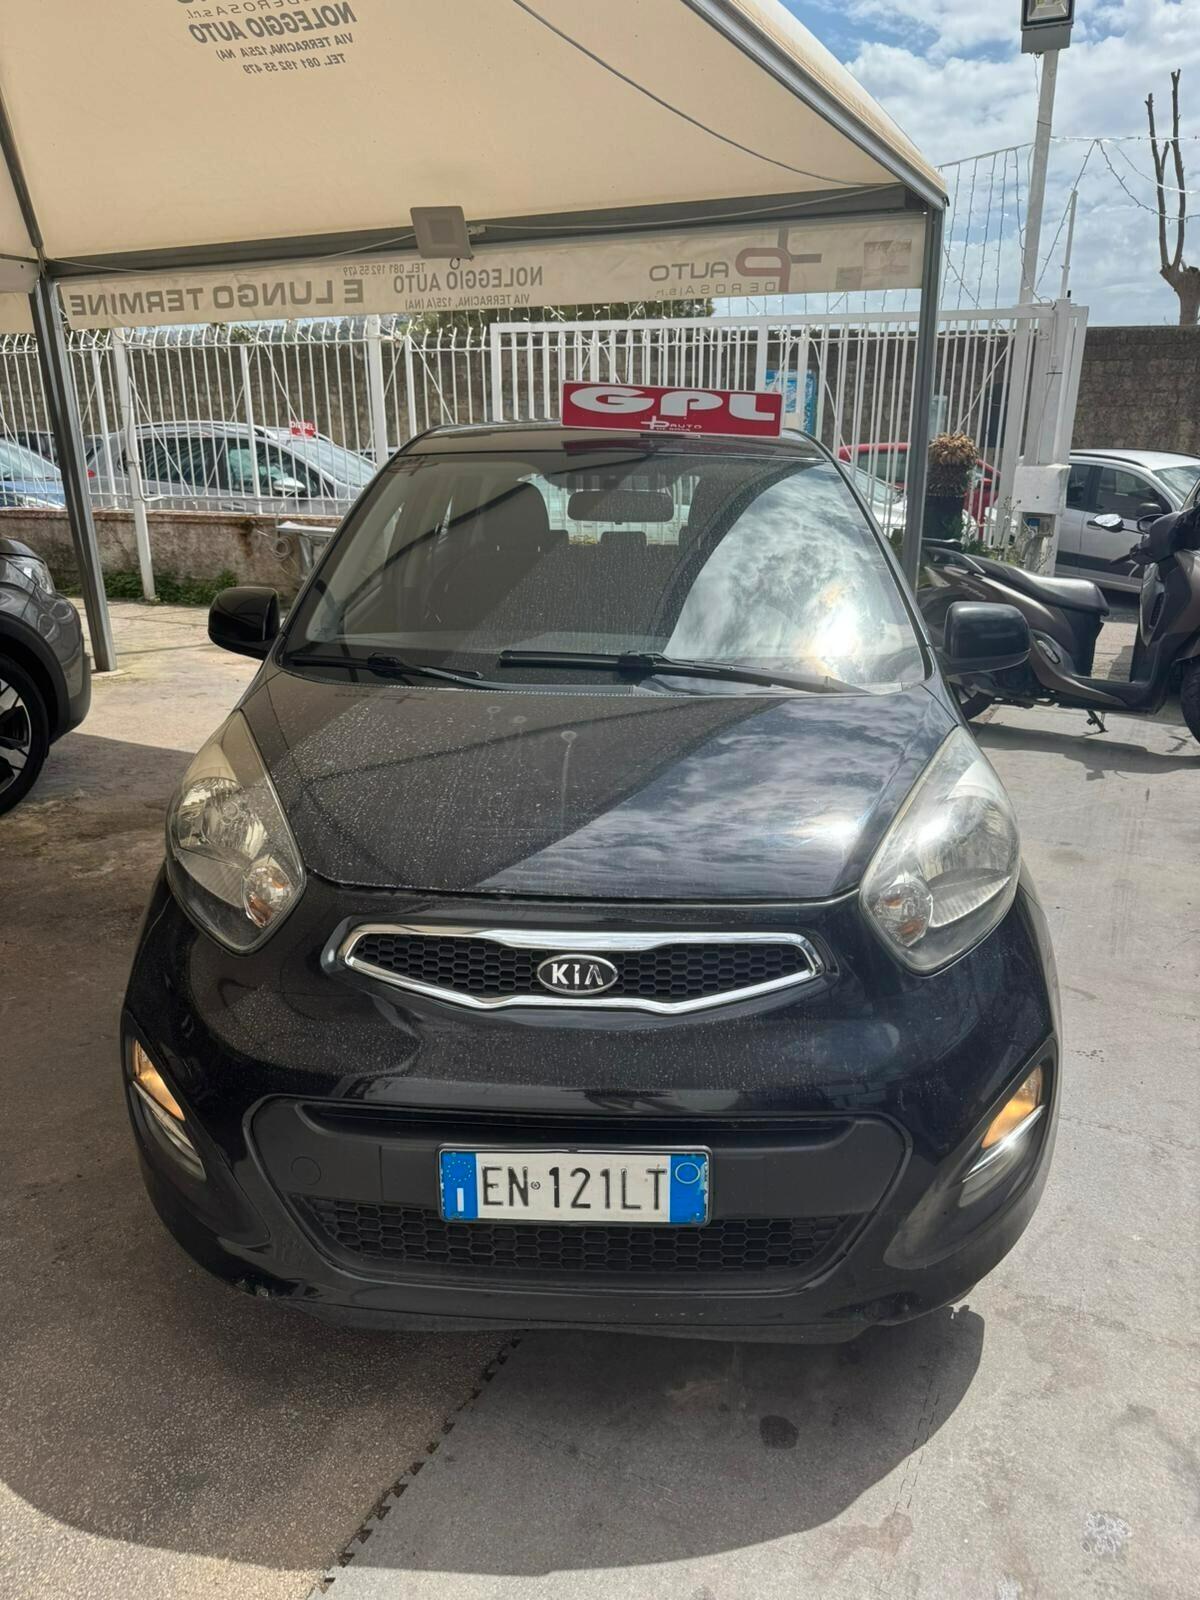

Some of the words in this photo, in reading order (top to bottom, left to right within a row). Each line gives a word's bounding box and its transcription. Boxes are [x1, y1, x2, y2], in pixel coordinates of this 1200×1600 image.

[569, 386, 775, 421] GPL
[550, 963, 604, 985] KIA
[481, 1165, 529, 1207] EN
[549, 1166, 668, 1211] 121LT
